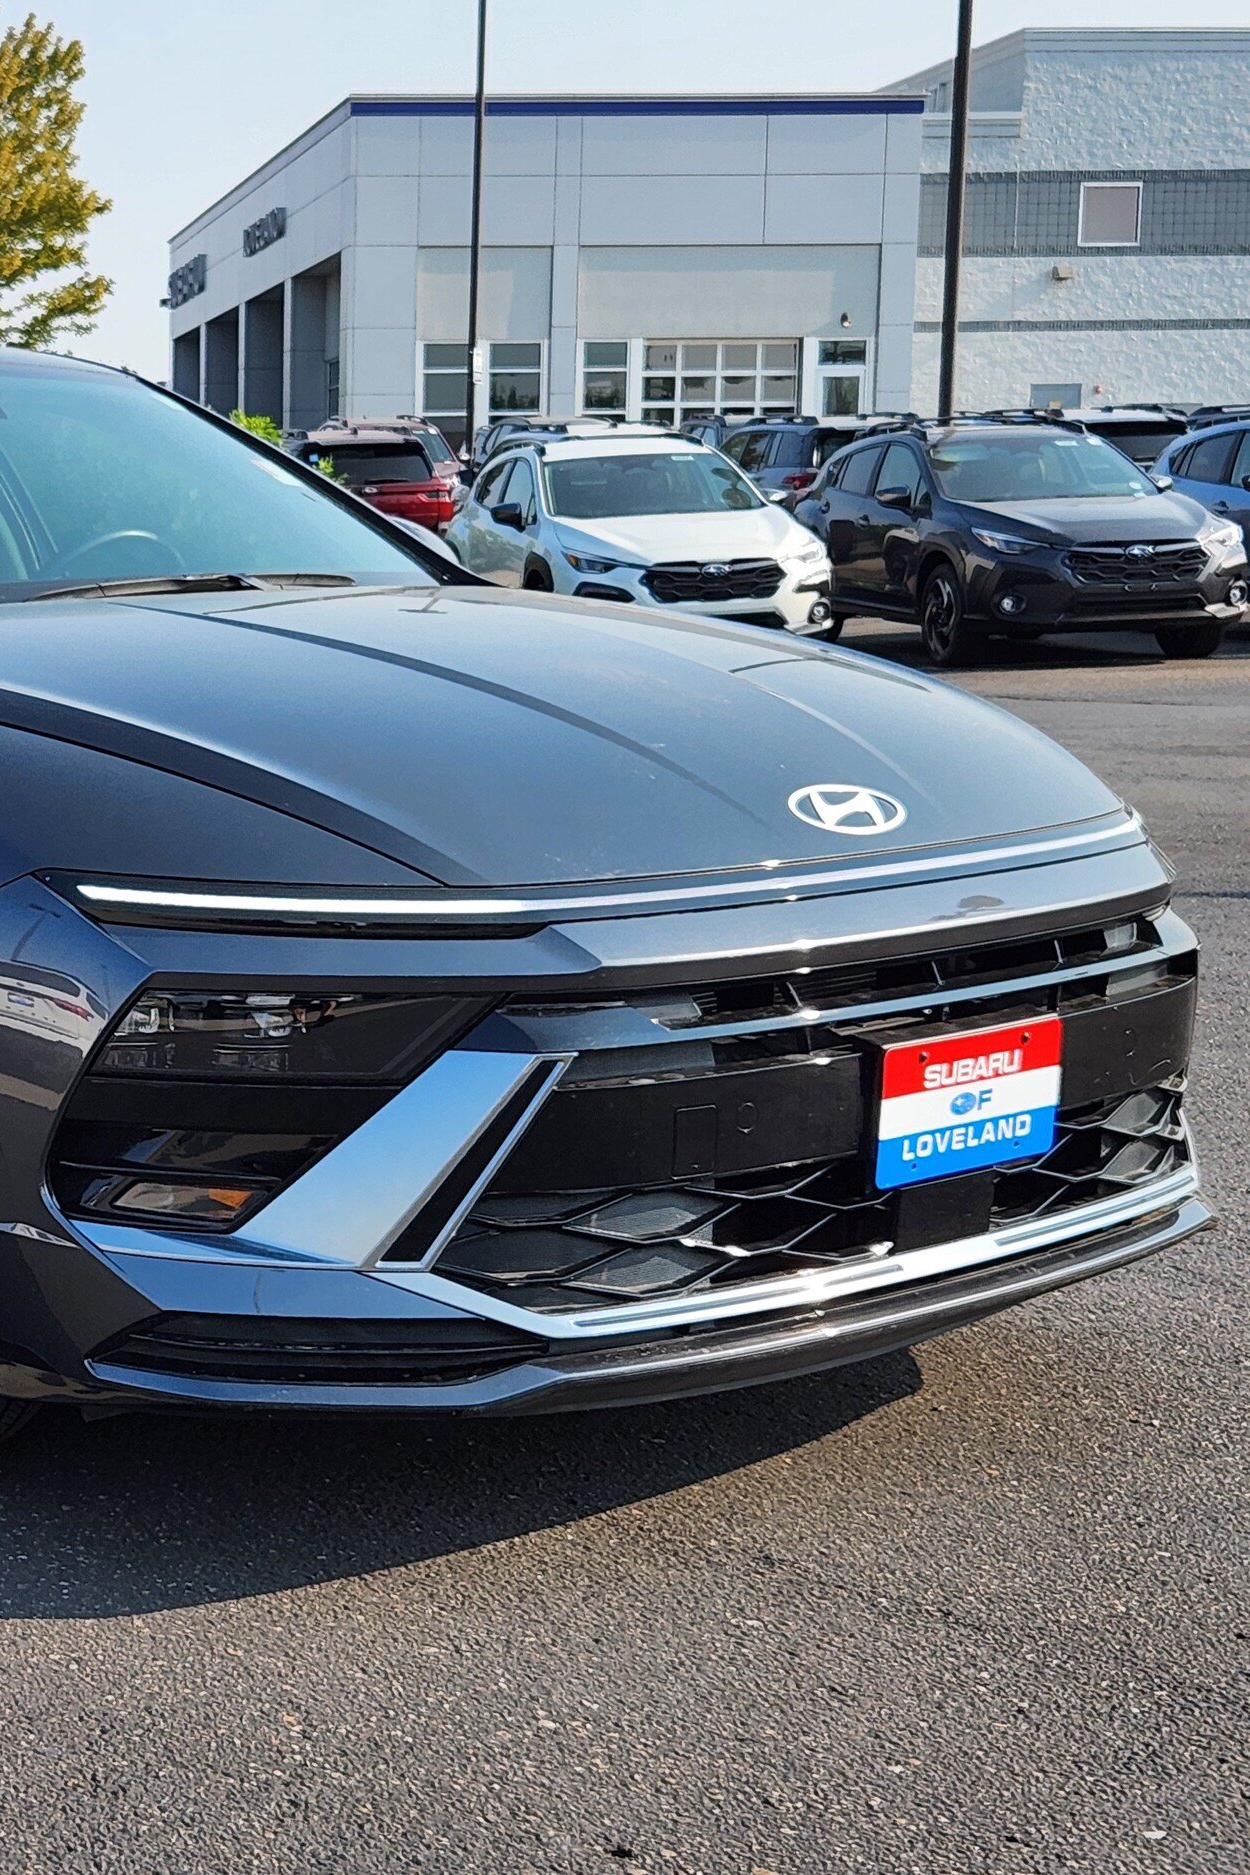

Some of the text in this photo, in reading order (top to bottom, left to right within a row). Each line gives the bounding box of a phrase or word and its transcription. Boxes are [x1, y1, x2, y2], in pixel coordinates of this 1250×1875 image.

[923, 1049, 1023, 1089] SUBARU
[950, 1088, 993, 1116] OF
[902, 1114, 1031, 1161] LOVELAND
